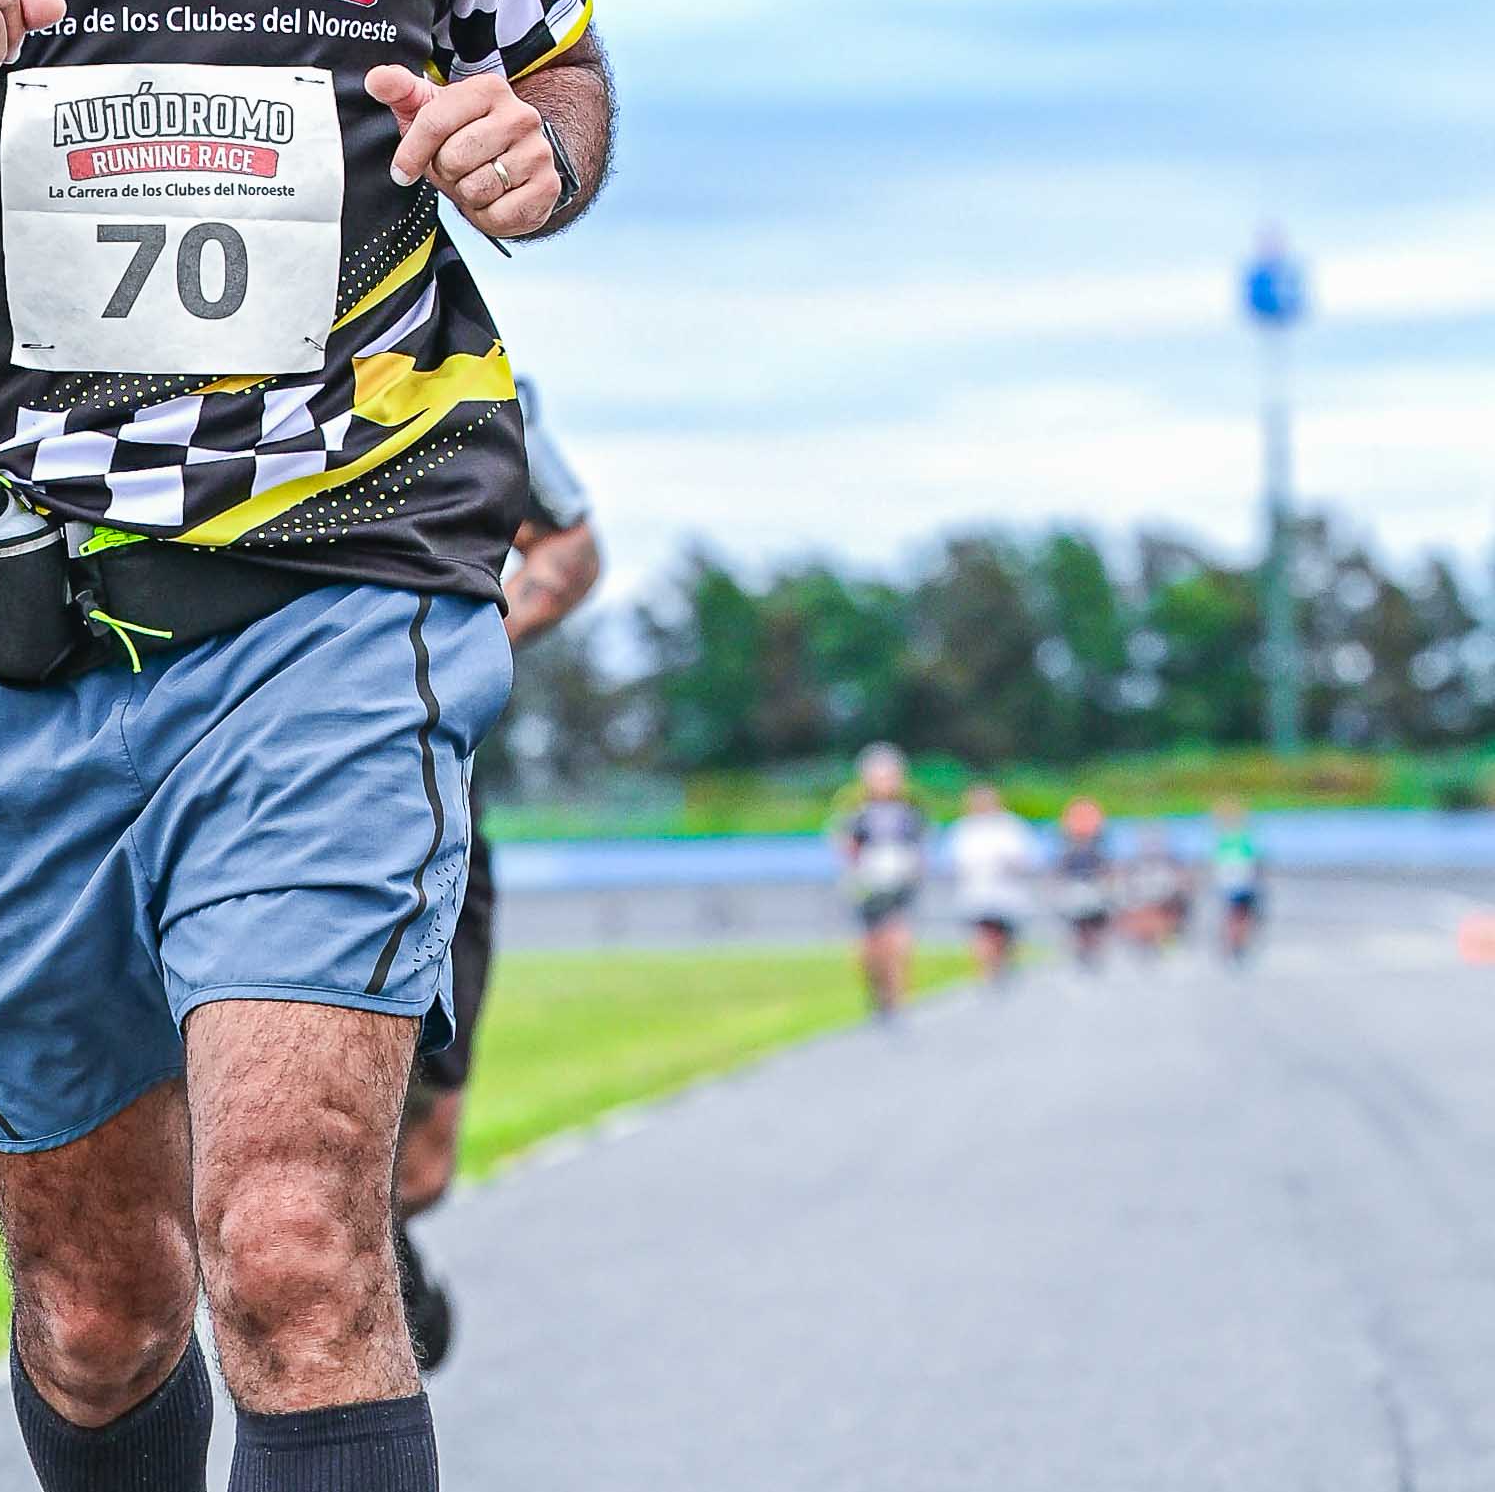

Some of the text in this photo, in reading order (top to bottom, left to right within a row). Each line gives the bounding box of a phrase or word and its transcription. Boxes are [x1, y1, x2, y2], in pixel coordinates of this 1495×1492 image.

[83, 7, 115, 33] de
[122, 6, 159, 33] los
[166, 5, 256, 33] Clubes
[262, 6, 301, 34] del
[307, 9, 398, 43] Noroeste
[53, 82, 294, 147] AUTÓDROMO
[91, 144, 256, 175] RUNNING RACE
[48, 182, 295, 199] La Carrera de los Clubes del Noroeste
[96, 221, 249, 320] 70
